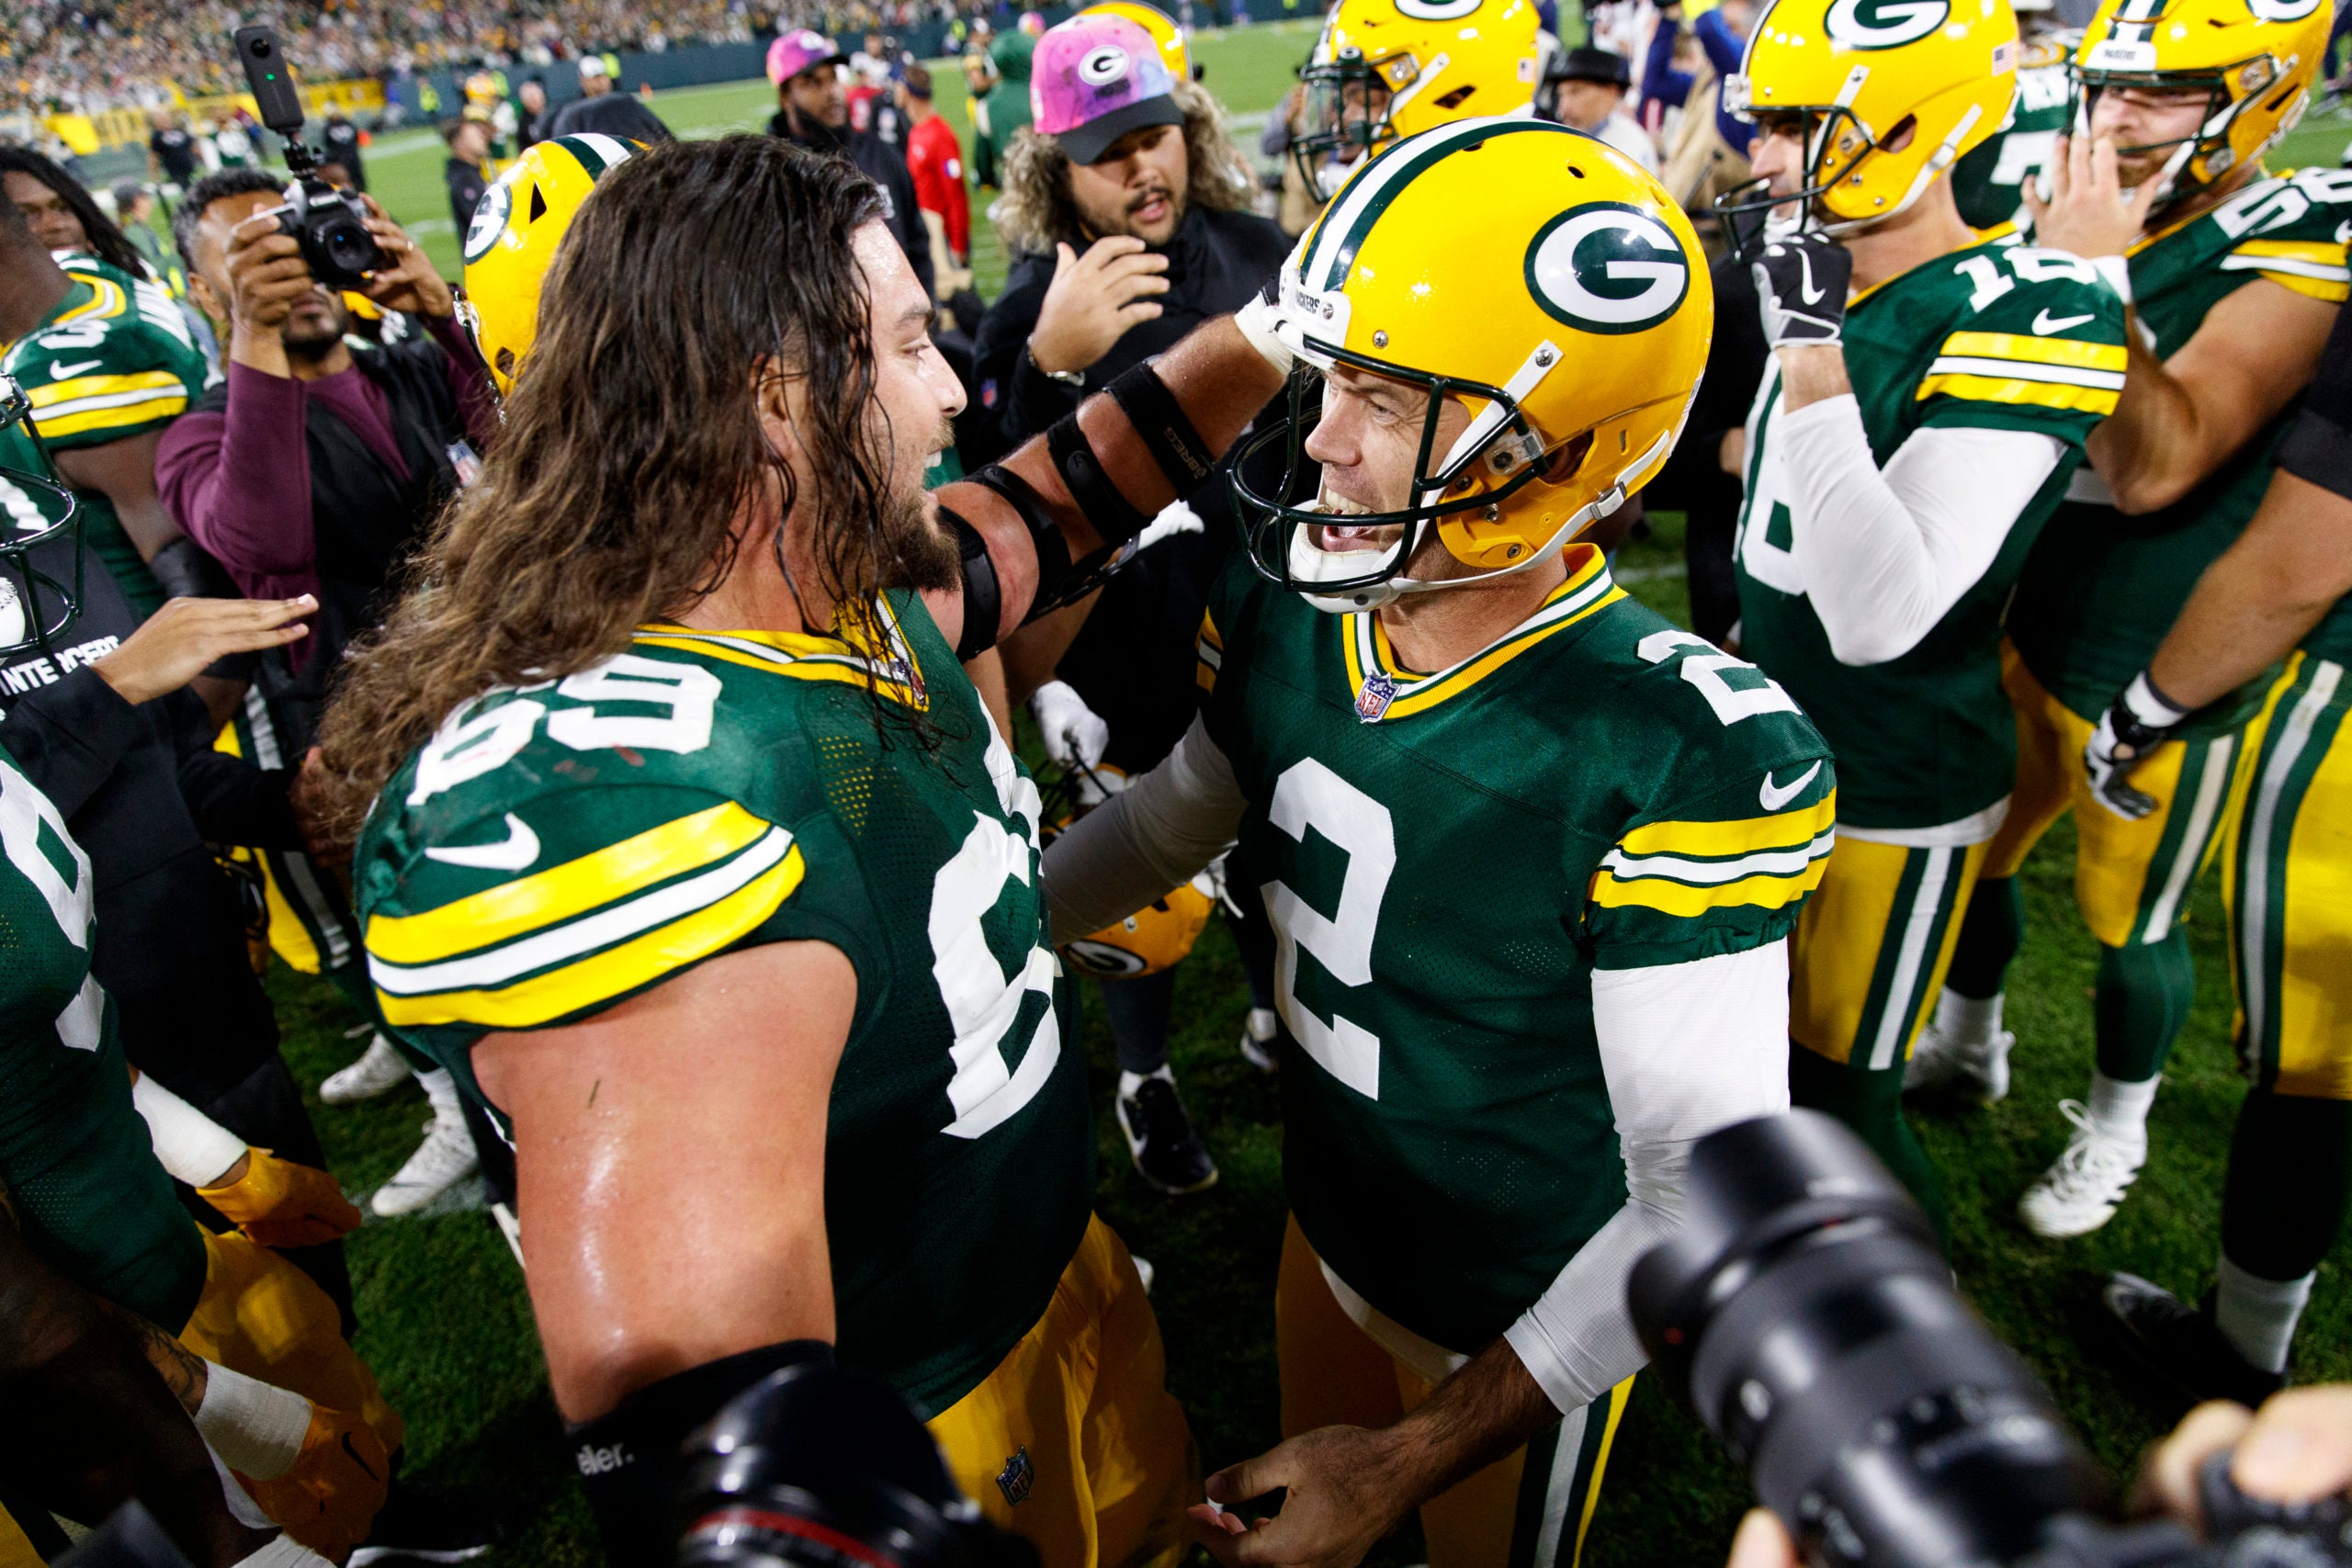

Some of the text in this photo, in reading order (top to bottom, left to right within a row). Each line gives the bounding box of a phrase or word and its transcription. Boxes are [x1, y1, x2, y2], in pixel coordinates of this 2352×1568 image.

[1081, 46, 1127, 84] G
[1533, 208, 1687, 325] G
[1358, 691, 1383, 716] NFL
[1637, 629, 1803, 726] 2
[1260, 756, 1396, 1101] 2
